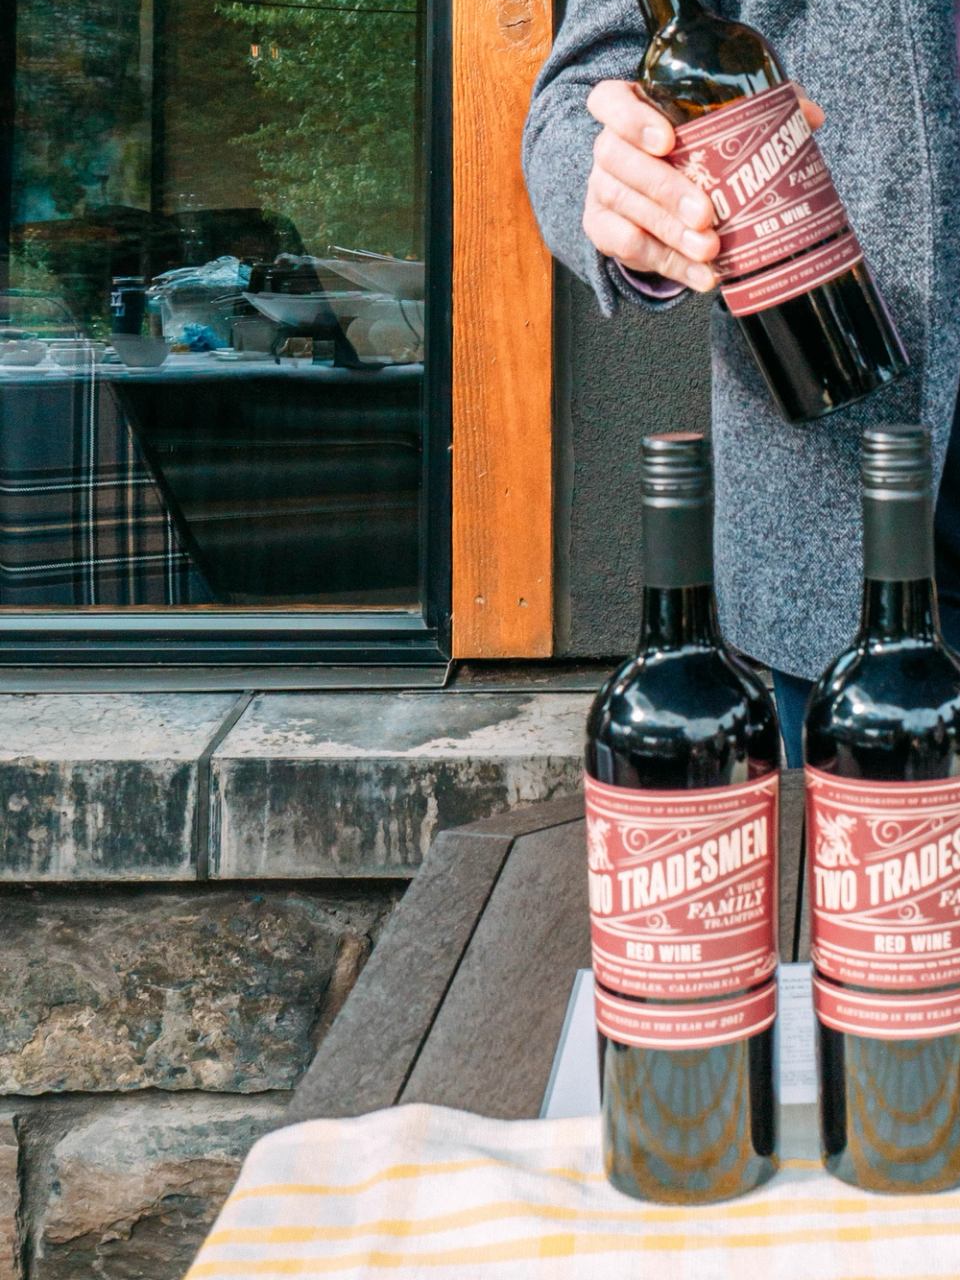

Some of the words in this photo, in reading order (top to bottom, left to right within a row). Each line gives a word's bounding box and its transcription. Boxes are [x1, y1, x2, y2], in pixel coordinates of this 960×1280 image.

[788, 160, 828, 187] FAMIL
[754, 220, 780, 238] RED
[781, 202, 813, 227] WINE
[617, 816, 768, 912] TRADESMEN
[686, 887, 766, 920] FAMILY
[813, 867, 858, 910] TWO
[626, 940, 654, 960] RED
[659, 942, 702, 962] WINE
[874, 934, 906, 953] RED
[911, 930, 952, 953] WINE
